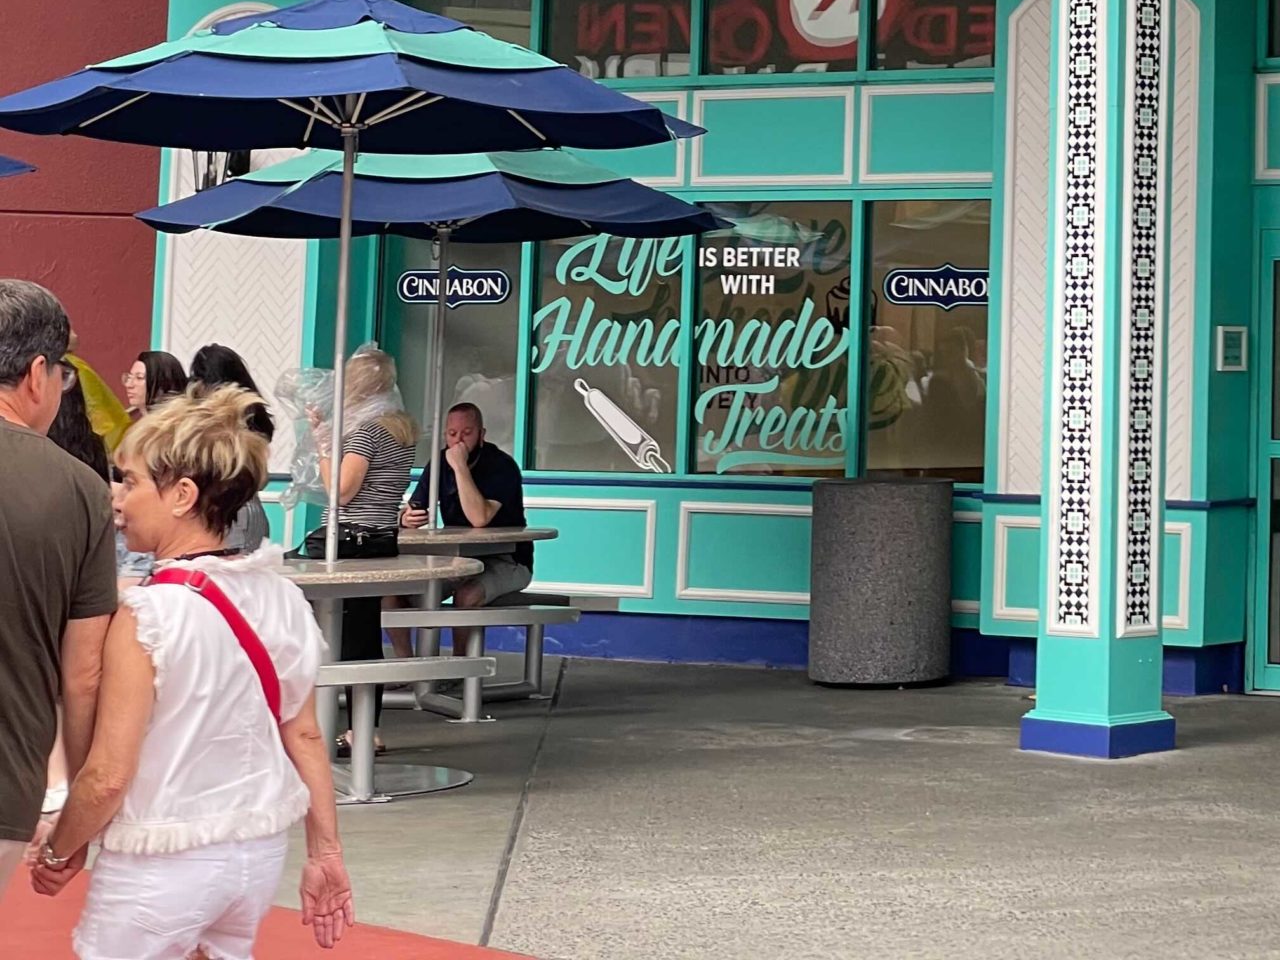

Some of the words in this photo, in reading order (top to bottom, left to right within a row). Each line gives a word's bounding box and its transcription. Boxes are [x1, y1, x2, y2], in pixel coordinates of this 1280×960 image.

[699, 247, 717, 267] IS
[722, 247, 801, 268] BETTER
[720, 274, 775, 295] WITH
[890, 275, 989, 298] CINNABO
[531, 296, 850, 373] Handmade
[694, 374, 848, 454] Treats
